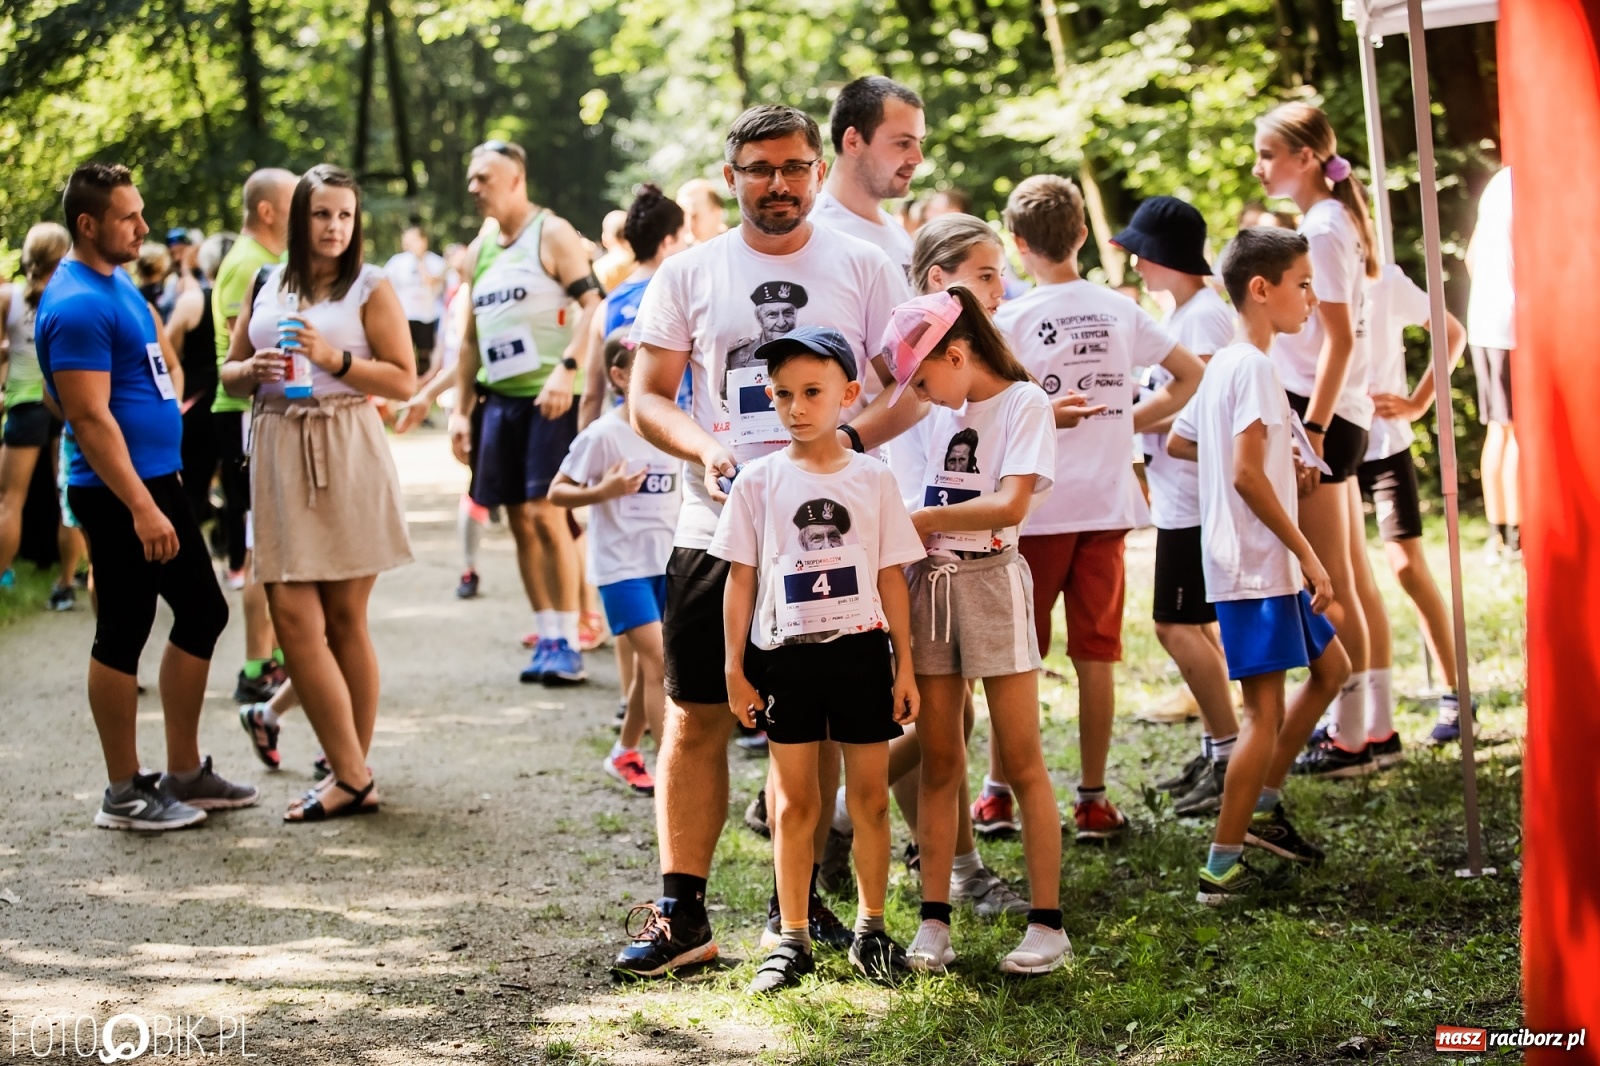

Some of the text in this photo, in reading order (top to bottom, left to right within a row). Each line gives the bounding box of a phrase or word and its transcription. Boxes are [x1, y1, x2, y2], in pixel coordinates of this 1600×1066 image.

[1081, 330, 1109, 339] EDYCJA
[1095, 379, 1124, 387] PGNiG
[646, 475, 673, 492] 60
[937, 490, 949, 507] 3
[812, 573, 831, 596] 4
